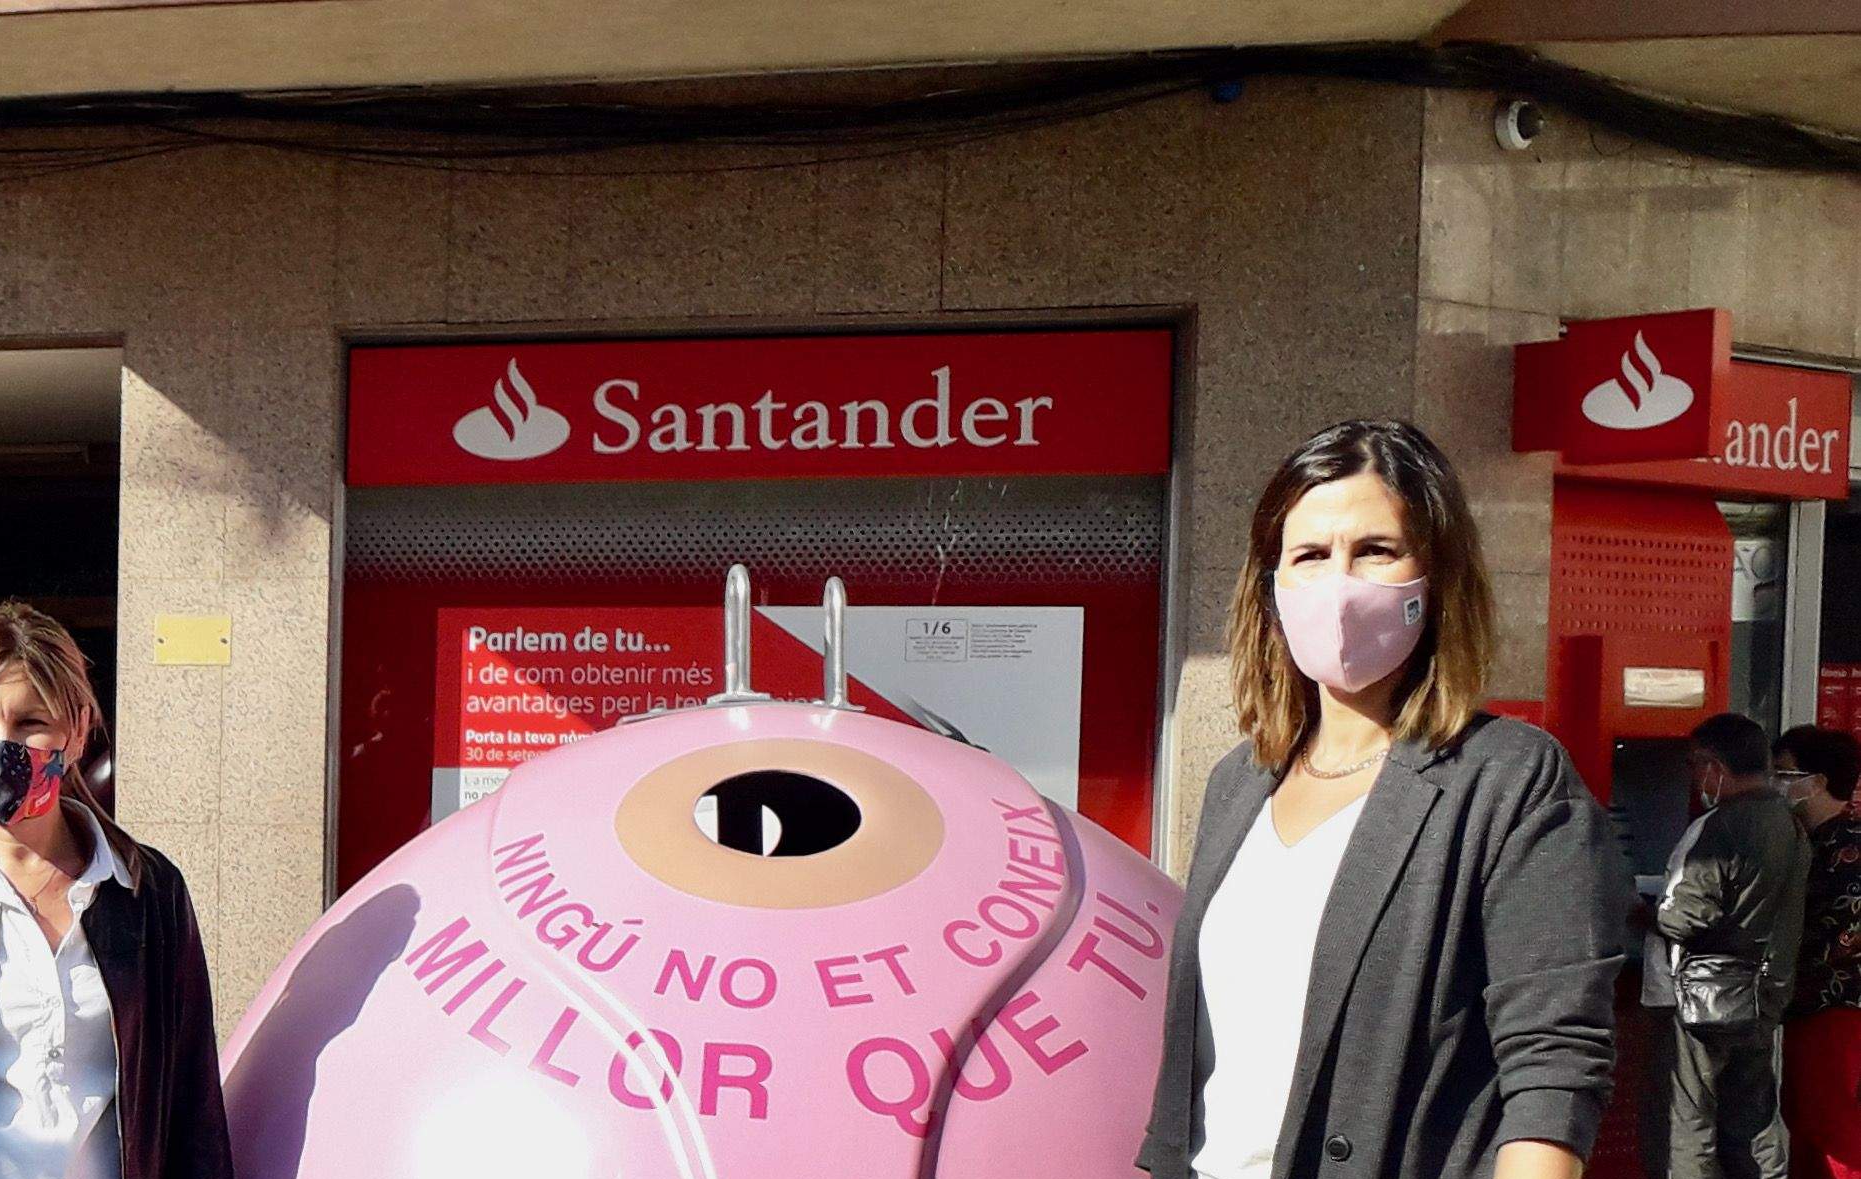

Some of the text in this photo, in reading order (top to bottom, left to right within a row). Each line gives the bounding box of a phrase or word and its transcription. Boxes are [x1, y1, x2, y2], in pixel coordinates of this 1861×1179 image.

[592, 366, 1053, 455] Santander
[1691, 397, 1839, 475] ander
[468, 626, 671, 652] Parlem de tu...
[923, 622, 952, 635] 1/6
[466, 660, 713, 686] i de com obtenir més
[466, 692, 594, 719] avantatges
[602, 696, 640, 717] per
[465, 729, 504, 744] Porta
[507, 730, 521, 744] la
[525, 731, 556, 744] teva
[465, 747, 483, 762] 30
[486, 747, 504, 762] de
[493, 797, 1065, 1009] NINGÚ NO ET CONEIX
[405, 916, 773, 1120] MILLOR
[846, 990, 1089, 1139] QUE
